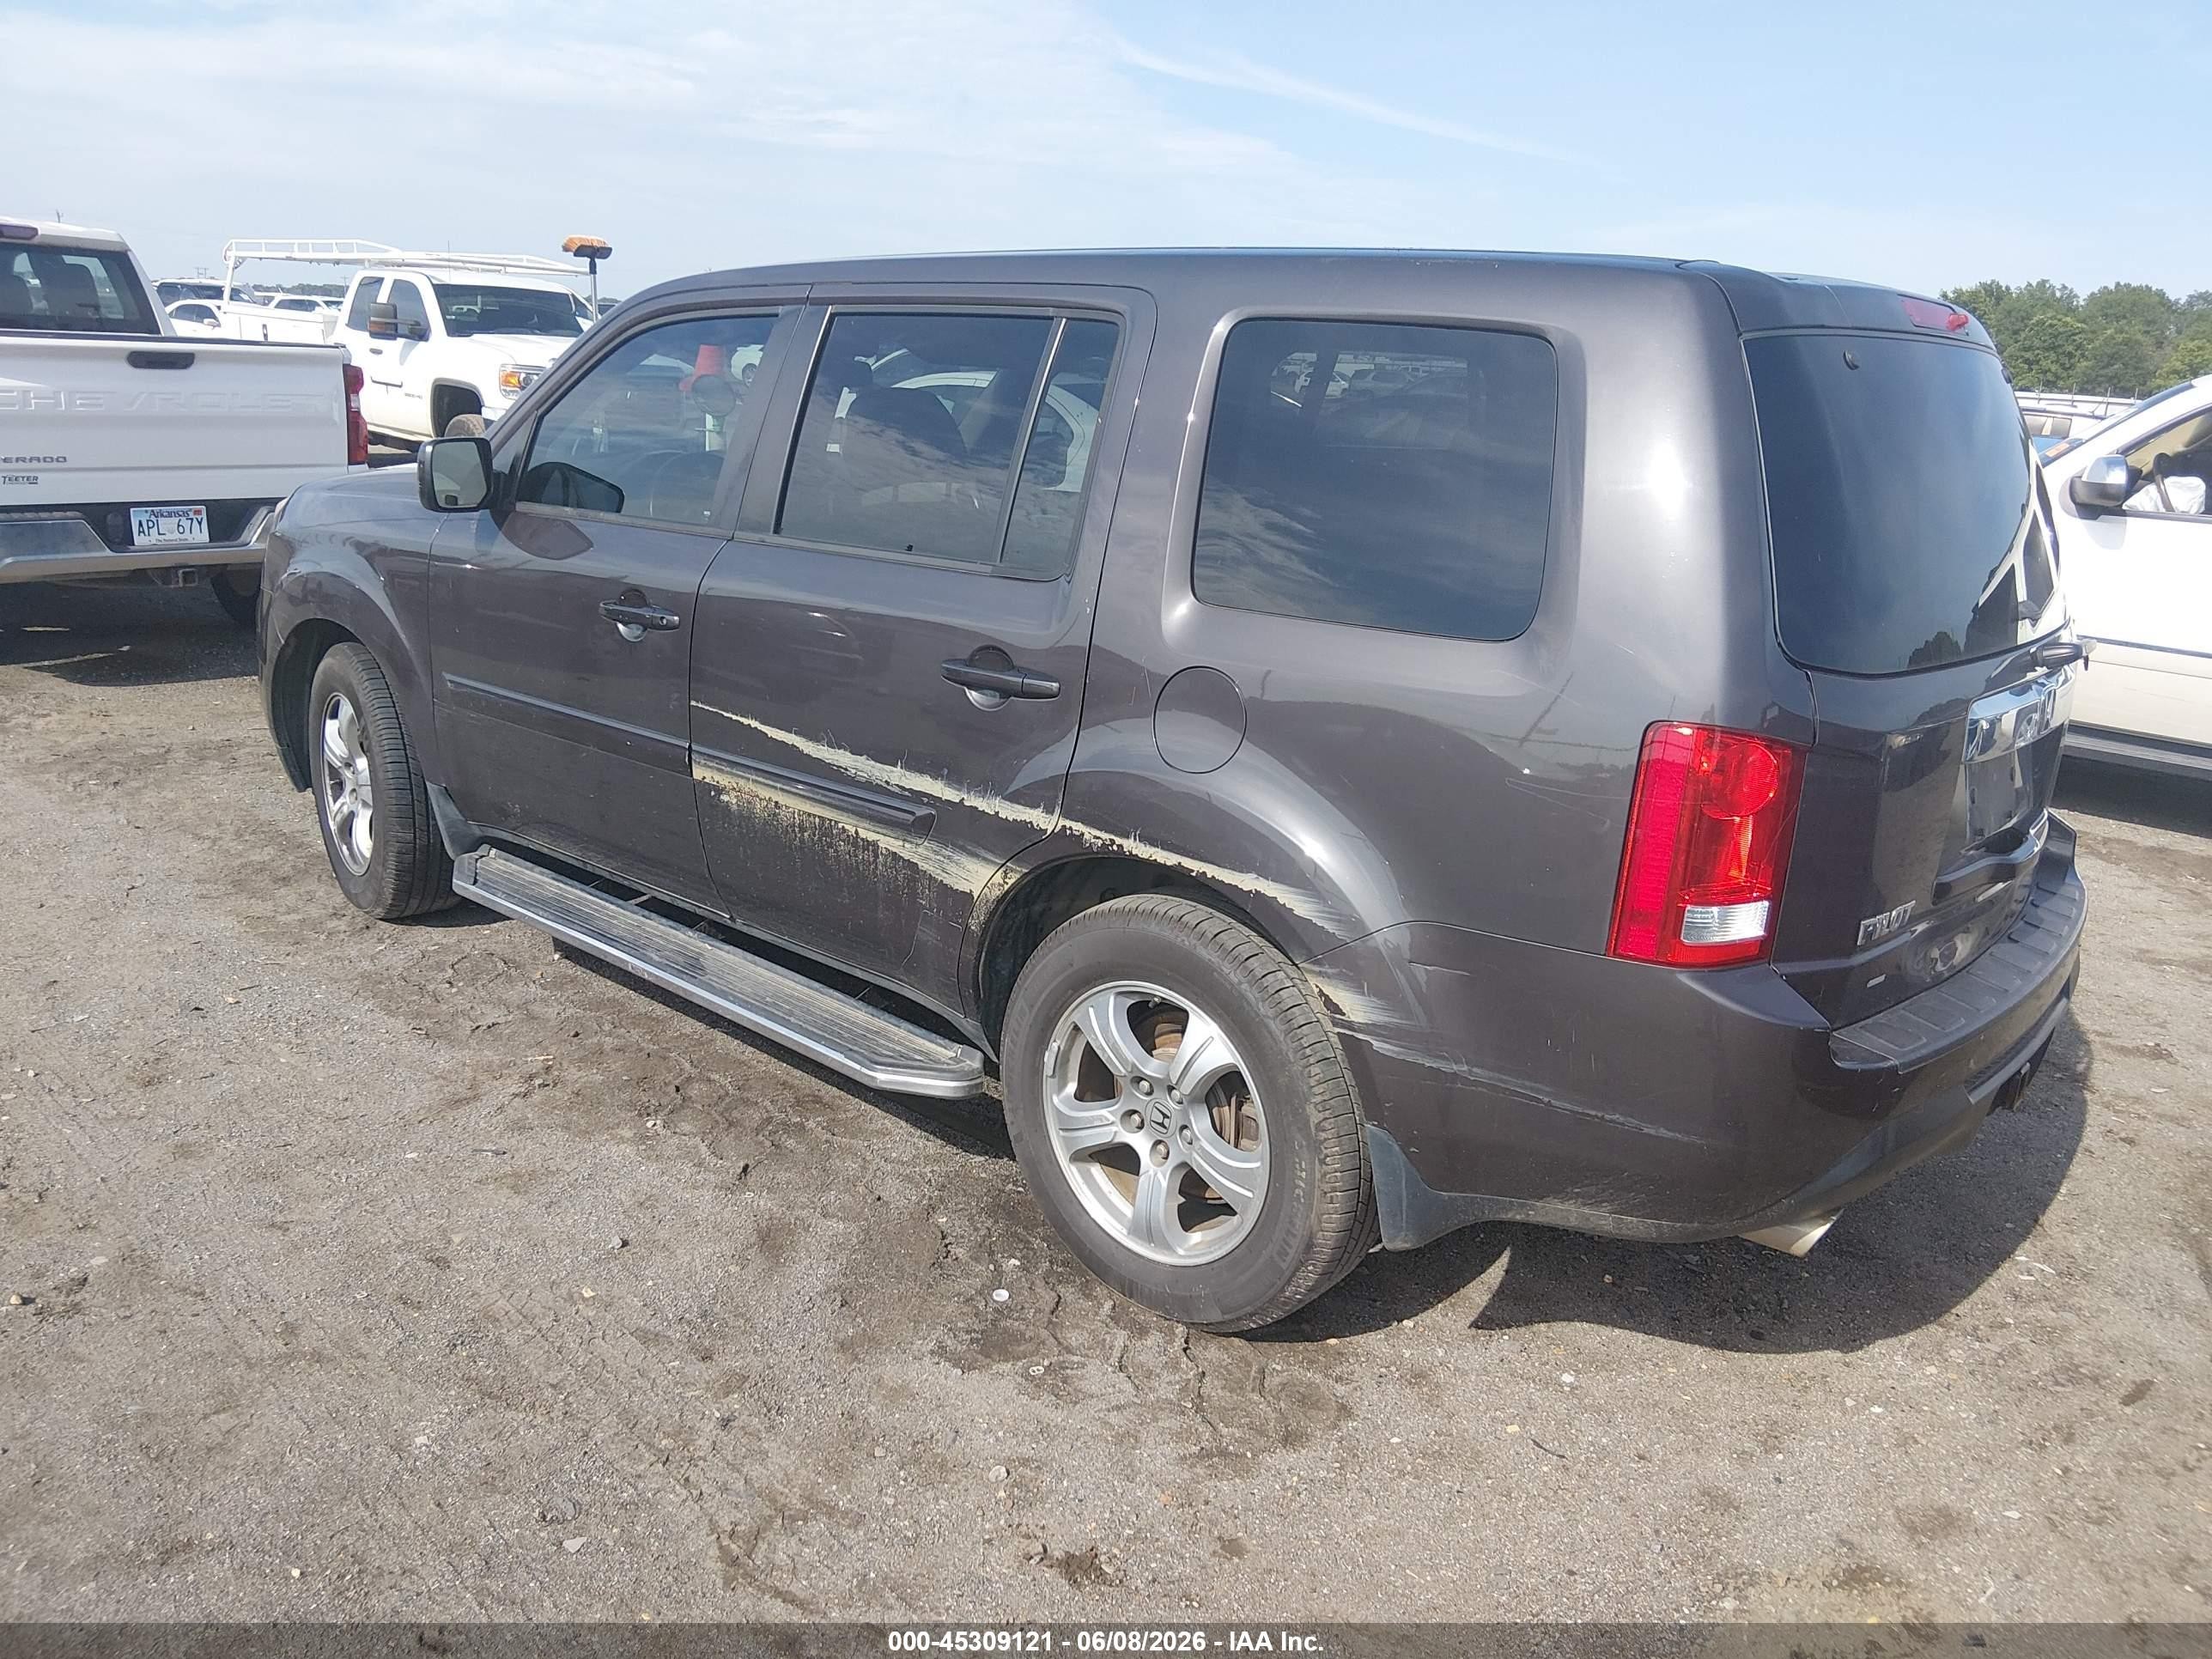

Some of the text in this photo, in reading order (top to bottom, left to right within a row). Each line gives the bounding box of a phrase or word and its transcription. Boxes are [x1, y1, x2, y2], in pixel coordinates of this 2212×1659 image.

[2, 475, 39, 485] TEETER
[149, 509, 191, 520] Arkansas
[137, 517, 204, 537] APL 67Y
[1856, 900, 1917, 946] PILOT
